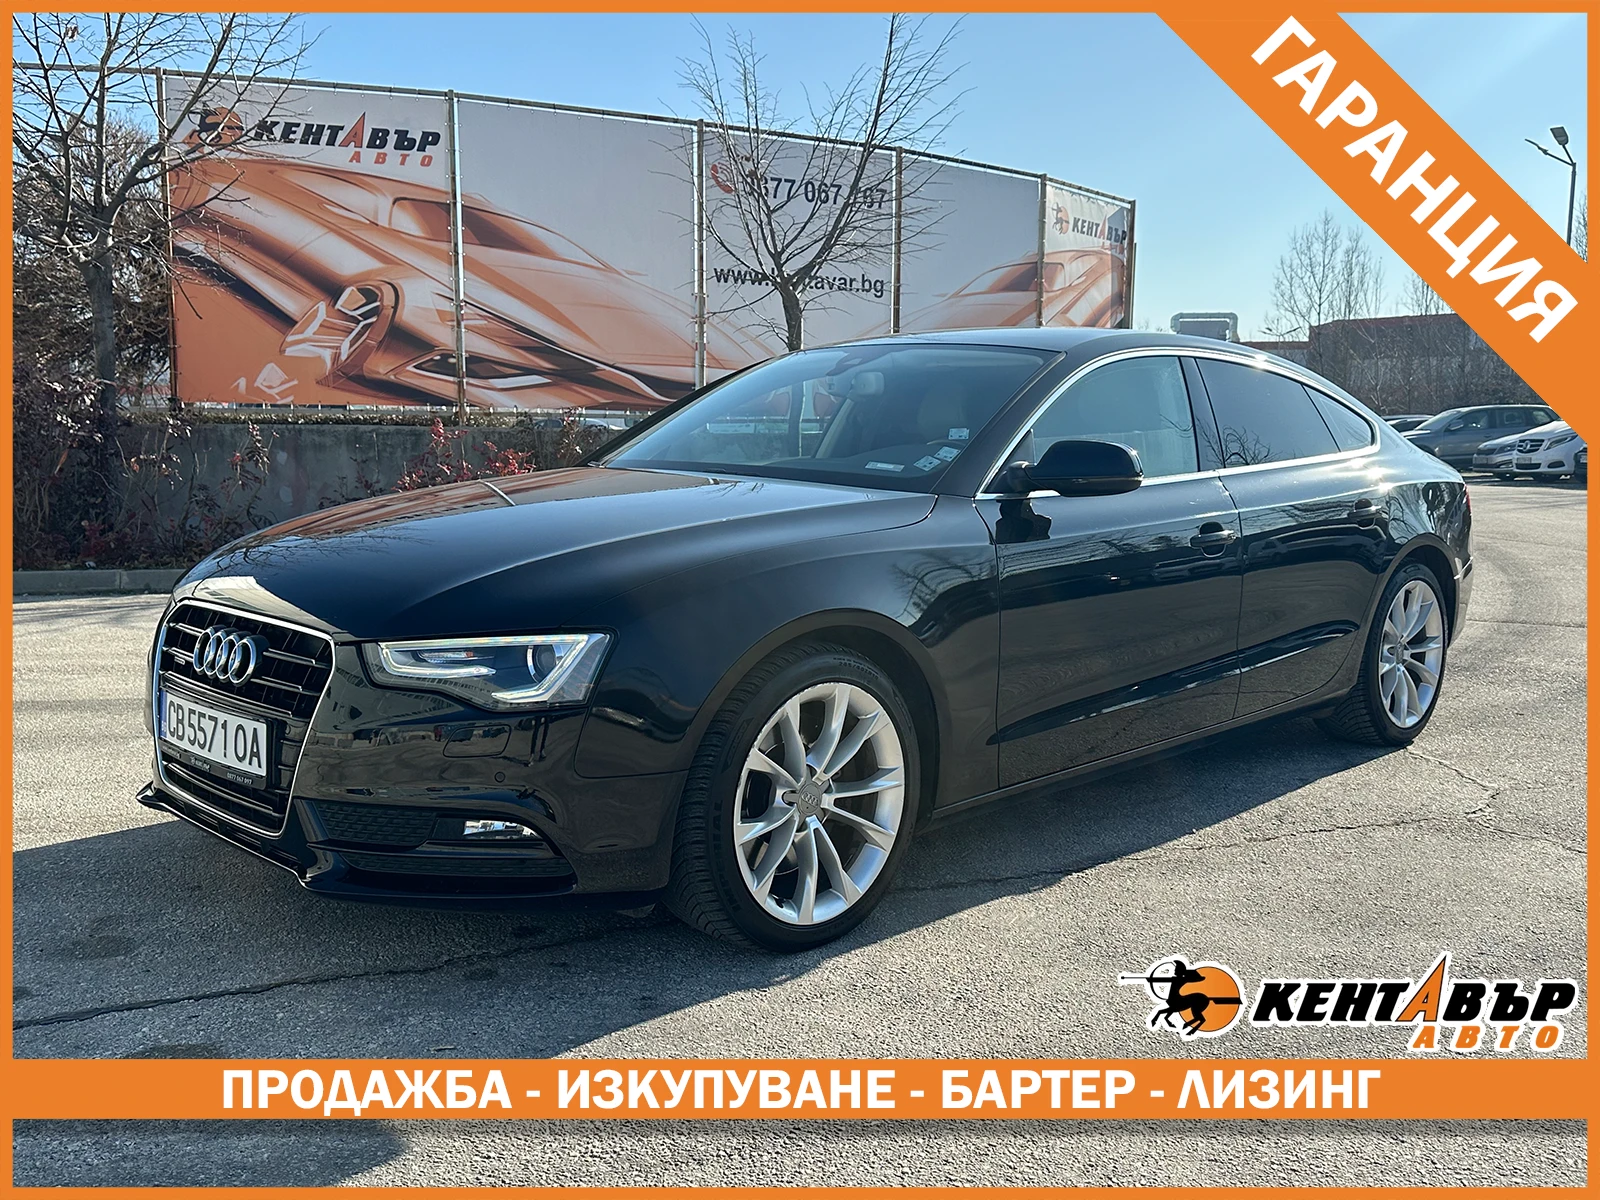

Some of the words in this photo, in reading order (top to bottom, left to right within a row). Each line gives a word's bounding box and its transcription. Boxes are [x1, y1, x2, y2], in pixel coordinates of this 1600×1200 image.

[253, 111, 441, 152] КЕНТАВЪР
[349, 150, 433, 167] АВТО
[804, 180, 842, 205] 067
[1072, 213, 1127, 245] КЕНТАВЪР
